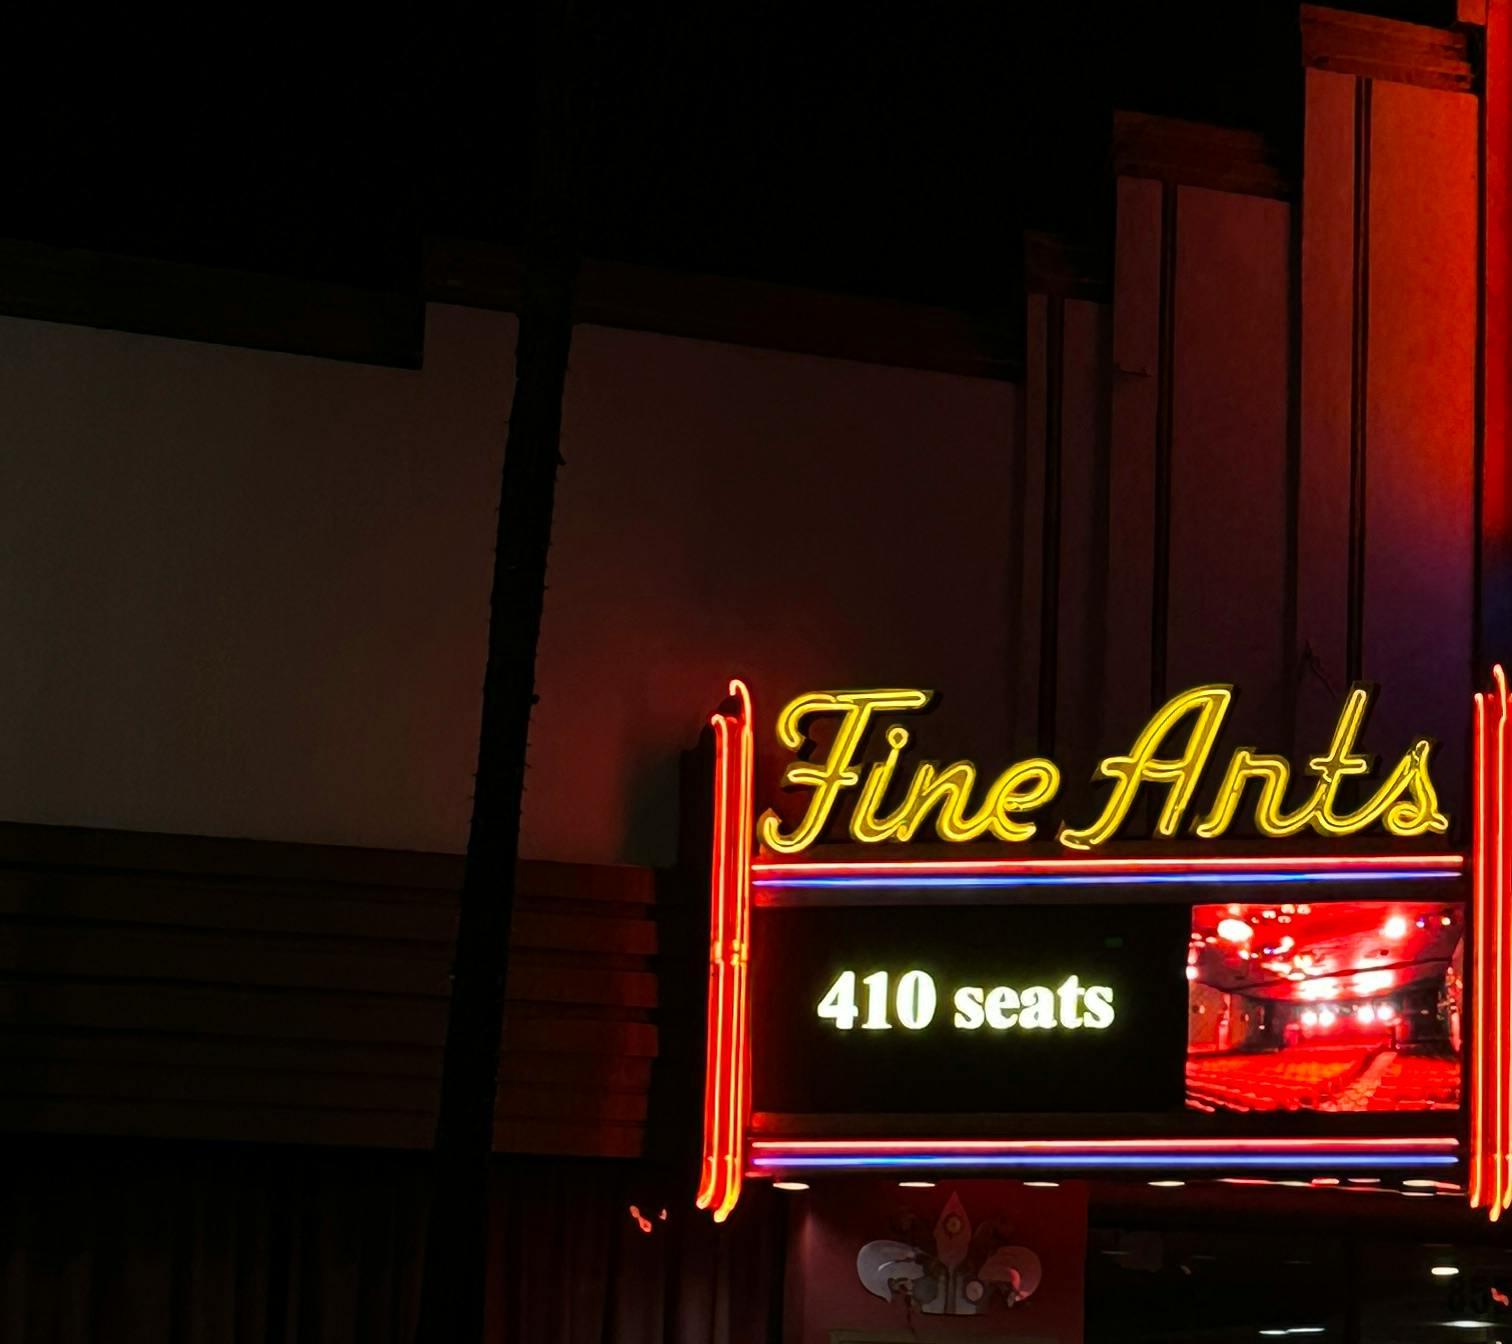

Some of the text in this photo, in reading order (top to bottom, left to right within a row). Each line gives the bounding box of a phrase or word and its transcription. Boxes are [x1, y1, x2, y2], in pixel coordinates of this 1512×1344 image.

[757, 680, 1450, 855] Fine Arts
[816, 968, 1116, 1031] 410 seats
